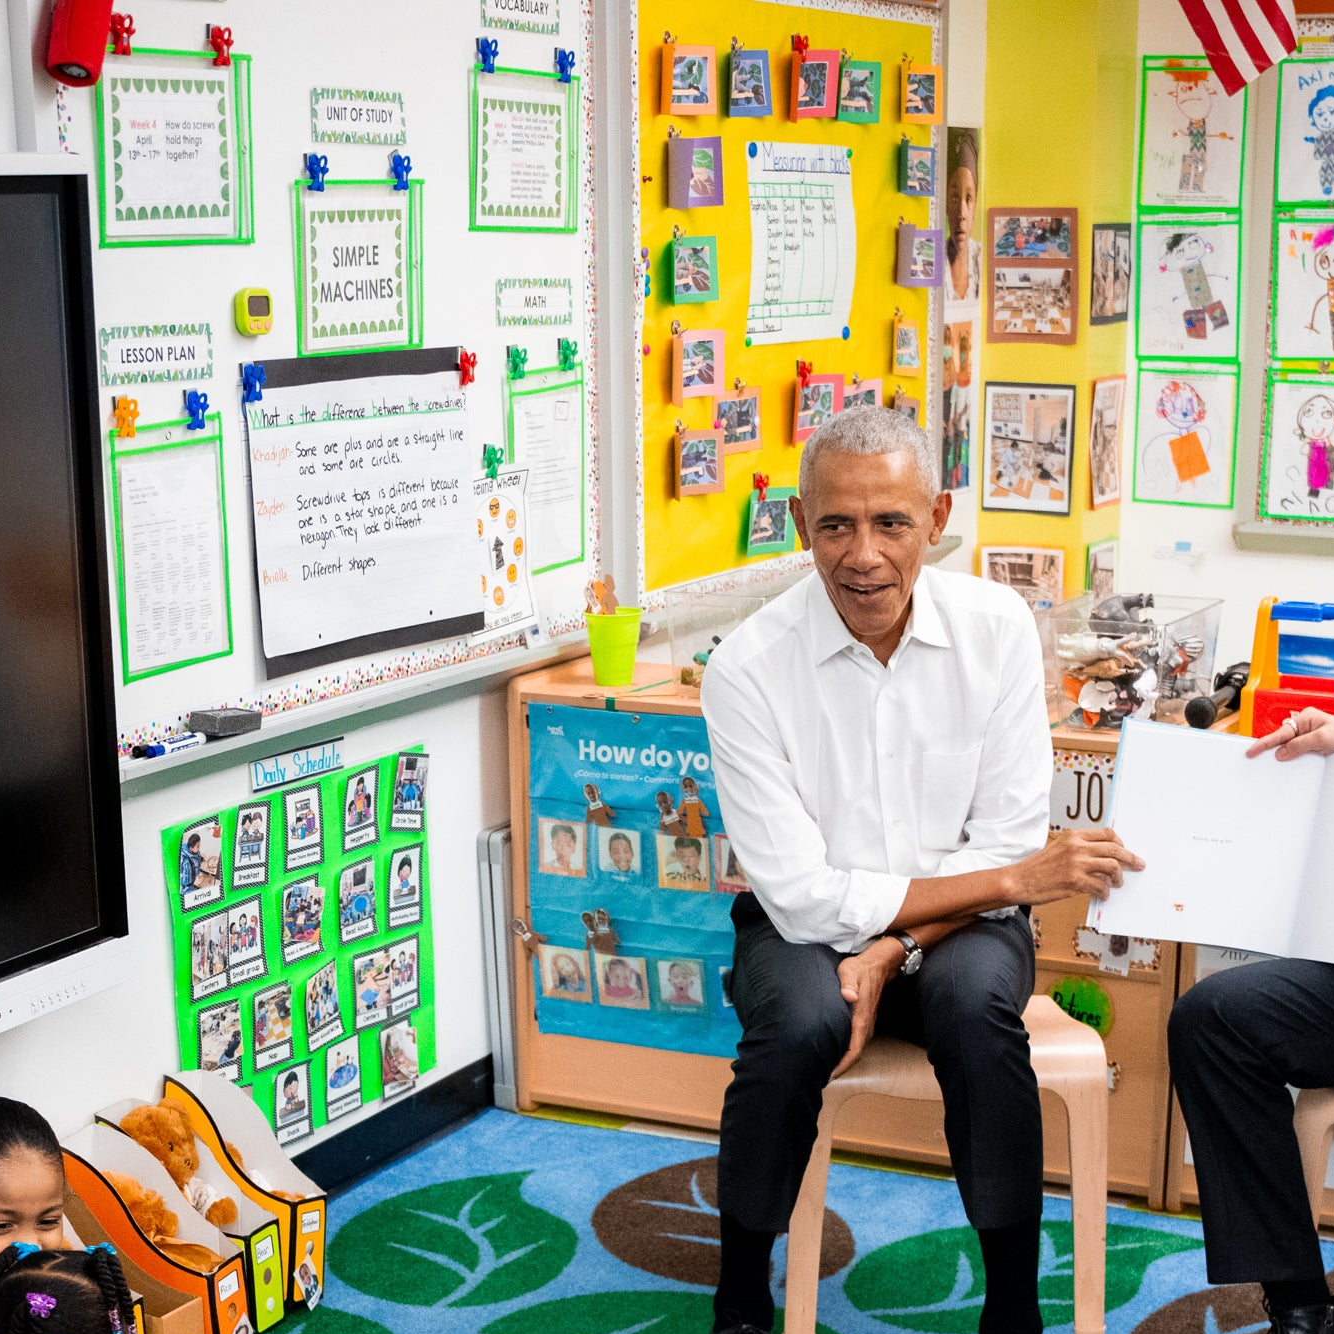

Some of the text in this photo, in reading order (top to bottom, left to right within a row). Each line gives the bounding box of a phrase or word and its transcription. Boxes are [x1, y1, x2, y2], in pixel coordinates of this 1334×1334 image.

[327, 106, 393, 124] UNIT OF STUDY
[130, 120, 157, 130] Week 4
[166, 120, 216, 130] How do screws
[136, 135, 153, 148] April
[166, 135, 203, 147] hold things
[166, 150, 199, 162] together?
[762, 142, 806, 185] Measuring
[811, 145, 825, 173] with
[333, 245, 379, 268] SIMPLE
[320, 277, 394, 304] MACHINES
[524, 295, 547, 309] MATH
[120, 345, 196, 364] LESSON PLAN
[248, 406, 280, 429] What
[287, 413, 294, 425] is
[299, 403, 316, 423] the
[322, 402, 365, 421] difference
[371, 396, 405, 417] between
[407, 395, 420, 412] the
[296, 441, 317, 458] Some
[323, 441, 338, 455] are
[344, 435, 362, 460] plus
[366, 433, 383, 450] and
[387, 436, 399, 448] are
[404, 436, 410, 446] a
[413, 428, 445, 451] straight
[449, 428, 464, 441] line
[298, 450, 403, 476] and some are circles.
[296, 490, 347, 512] Screwdrive
[378, 486, 386, 499] is
[389, 478, 425, 499] different
[430, 477, 459, 492] because
[298, 516, 314, 529] one
[320, 514, 328, 524] is
[334, 513, 341, 522] a
[345, 507, 364, 522] star
[401, 499, 418, 513] and
[422, 497, 436, 509] one
[440, 495, 447, 506] is
[452, 494, 458, 505] a
[336, 524, 358, 543] They
[363, 521, 381, 536] look
[302, 556, 343, 581] Different
[578, 739, 715, 776] How do yo
[254, 743, 342, 787] Daily Schedule
[395, 817, 417, 825] Circle Time
[349, 831, 371, 845] Heggerty
[238, 871, 261, 882] Breakfast
[193, 891, 212, 902] Arrival
[345, 923, 369, 936] Read Aloud
[1220, 949, 1250, 961] /m/
[233, 965, 261, 980] Small group
[201, 980, 220, 993] Centers
[362, 1013, 380, 1023] Centers
[268, 1051, 279, 1061] Nap
